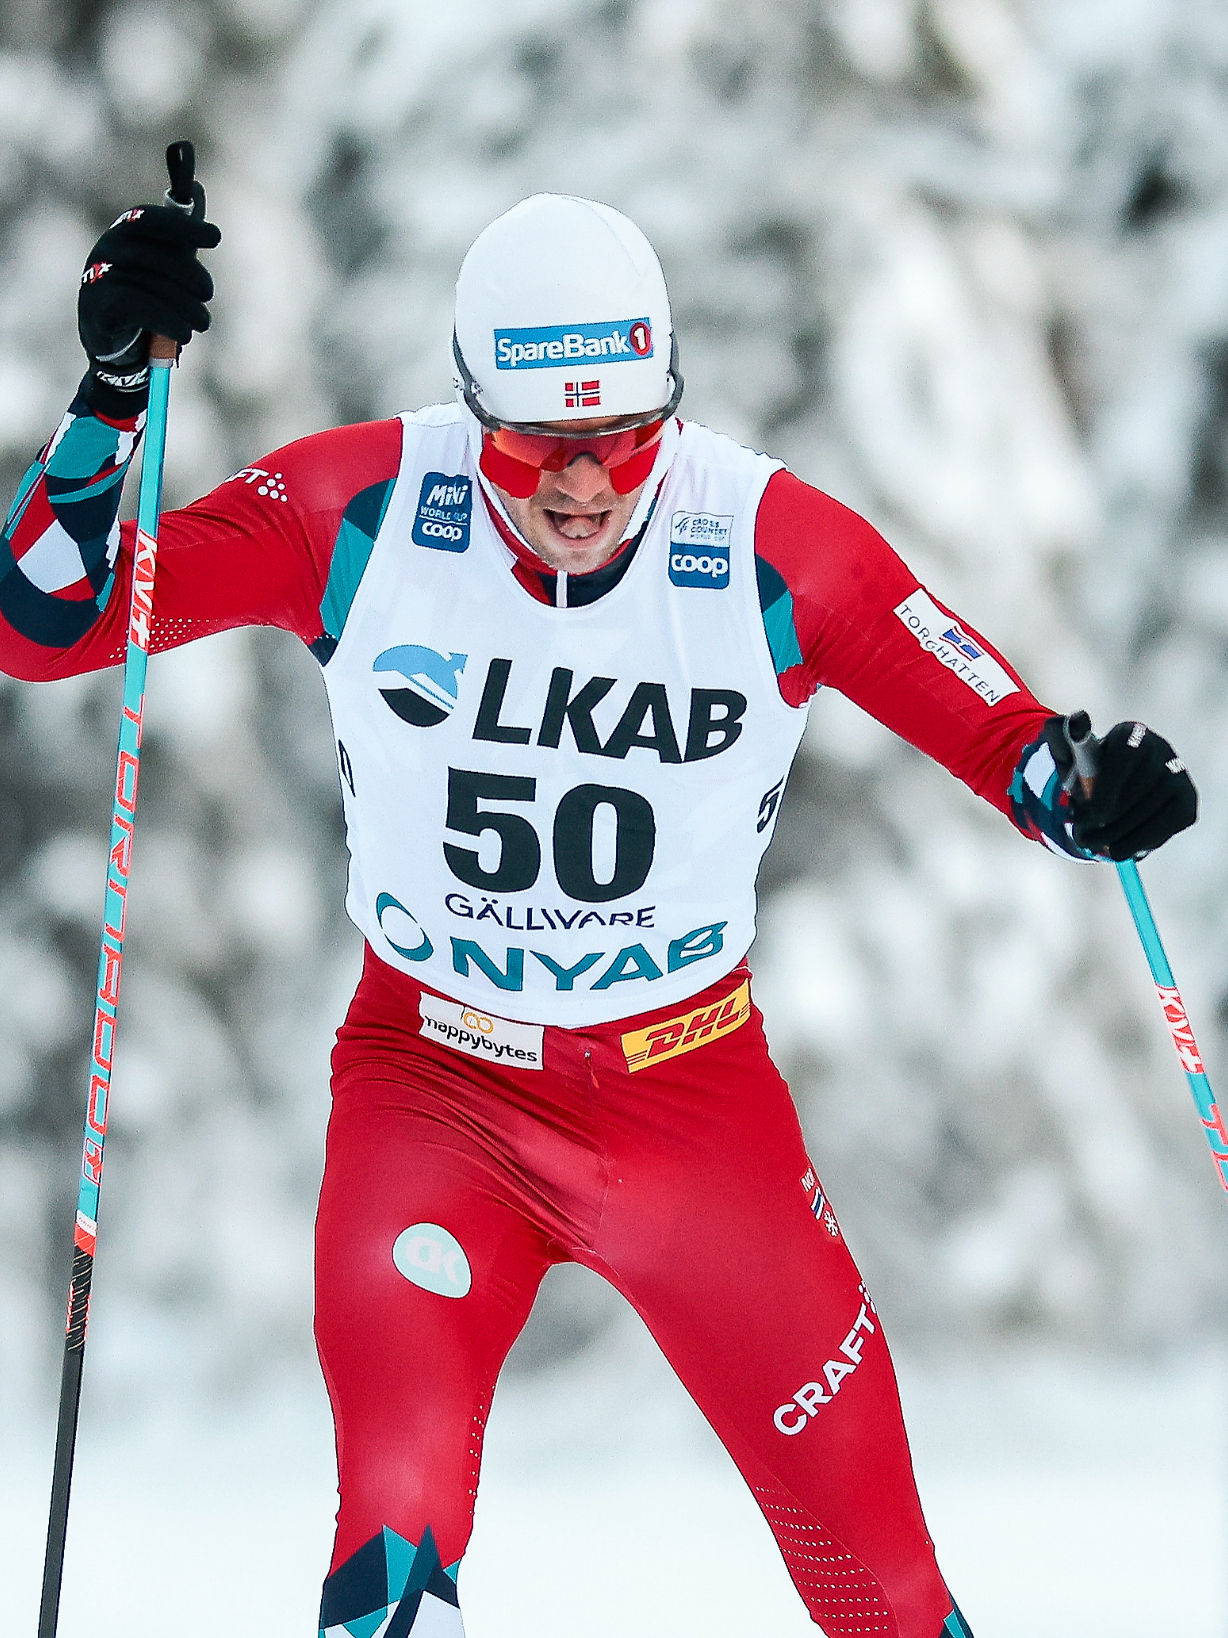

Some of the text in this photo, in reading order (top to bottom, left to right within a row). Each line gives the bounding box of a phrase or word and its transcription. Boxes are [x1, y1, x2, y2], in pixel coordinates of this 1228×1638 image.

[899, 604, 1001, 703] TORGHATTEN
[472, 658, 748, 764] LKAB
[443, 766, 656, 904] 50
[444, 893, 657, 931] GÄLLIVARE
[450, 921, 729, 991] NYAB
[645, 1000, 741, 1059] DHL
[773, 1302, 876, 1436] CRAFT
